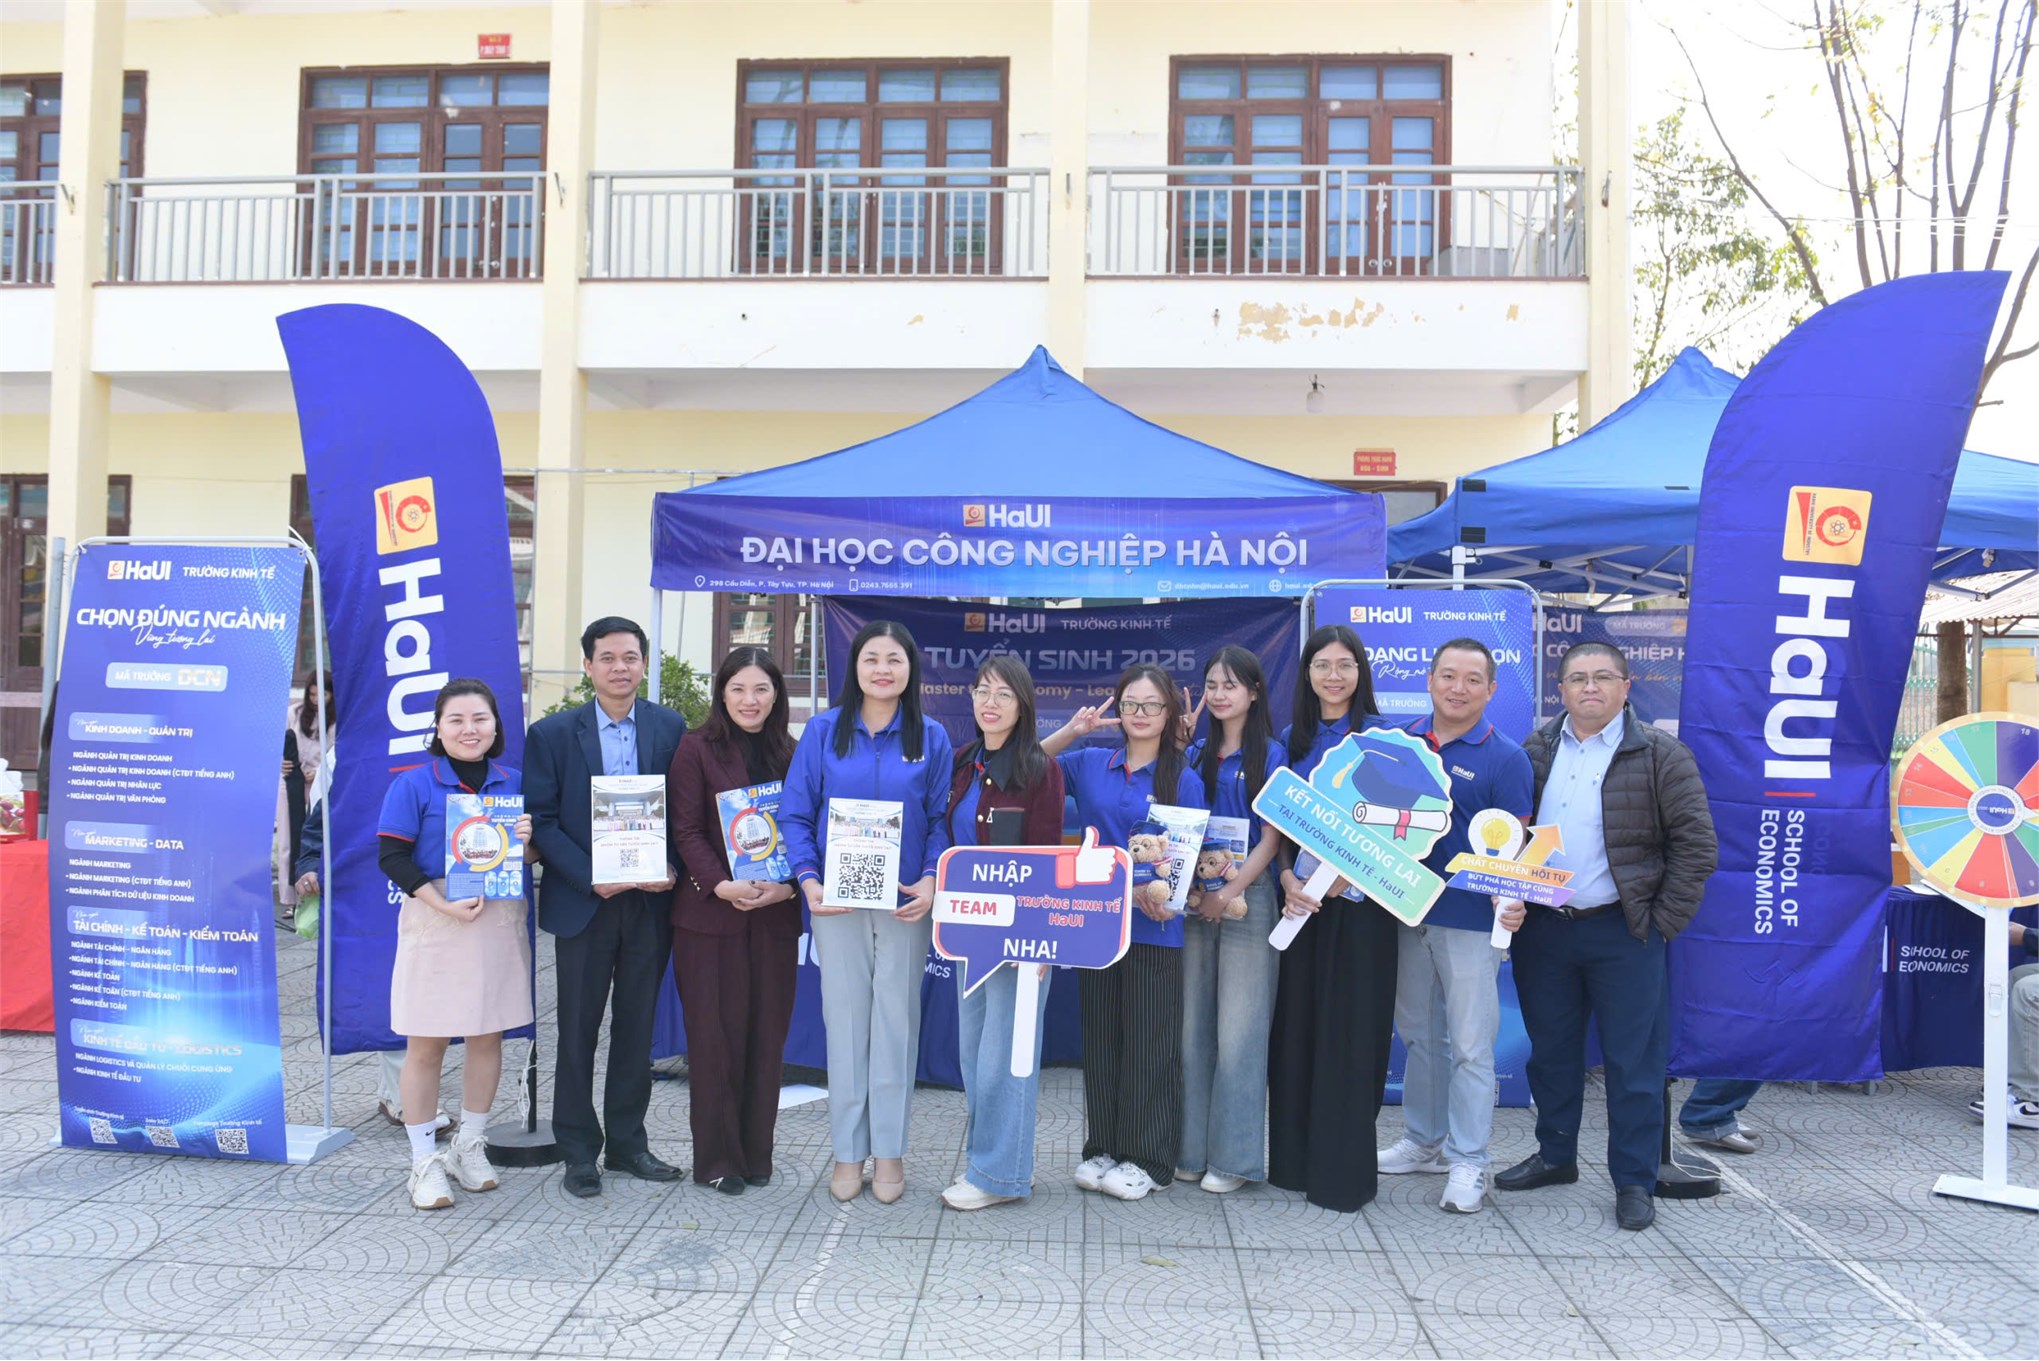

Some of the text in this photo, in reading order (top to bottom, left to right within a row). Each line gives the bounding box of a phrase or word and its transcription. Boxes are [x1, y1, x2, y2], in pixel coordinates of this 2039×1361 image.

[989, 504, 1051, 528] HaUI
[740, 531, 1308, 575] ĐẠI HỌC CÔNG NGHIỆP HÀ NỘI
[125, 560, 277, 581] HaUI TRƯỜNG KINH TẾ
[76, 604, 287, 630] CHỌN ĐÚNG NGÀNH
[988, 613, 1173, 634] HaUI TRƯỜNG KINH TẾ
[1368, 607, 1507, 624] HaUI TRƯỜNG KINH TẾ
[378, 558, 450, 756] HaUI
[1038, 649, 1112, 671] SINH
[177, 668, 222, 687] DCN
[1763, 574, 1856, 780] HaUI
[85, 725, 193, 738] KINH DOANH QUẢN TRỊ
[758, 783, 782, 797] HaUI
[495, 796, 523, 808] HaUI
[85, 835, 184, 850] MARKETING DATA
[1284, 785, 1422, 888] KẾT NỐI TƯƠNG LAI
[1278, 804, 1405, 899] TẠI TRƯỜNG KINH TẾ HaUI
[972, 860, 1033, 887] NHẬP
[1531, 869, 1551, 880] HỘI
[1552, 873, 1567, 883] TỤ
[1754, 809, 1781, 935] ECONOMICS
[1779, 809, 1806, 927] SCHOOL OF
[1467, 881, 1553, 905] TRƯỜNG KINH TẾ HaUI
[1468, 872, 1554, 895] BỨT PHÁ HỌC TẬP CÙNG
[949, 899, 998, 916] TEAM
[1016, 895, 1123, 914] TRƯỜNG KINH TẾ
[73, 919, 259, 942] TÀI CHÍNH KẾ TOÁN KIỂM TOÁN
[1048, 912, 1085, 928] HaUI
[1003, 938, 1058, 960] NHA!
[1951, 949, 1971, 960] OF
